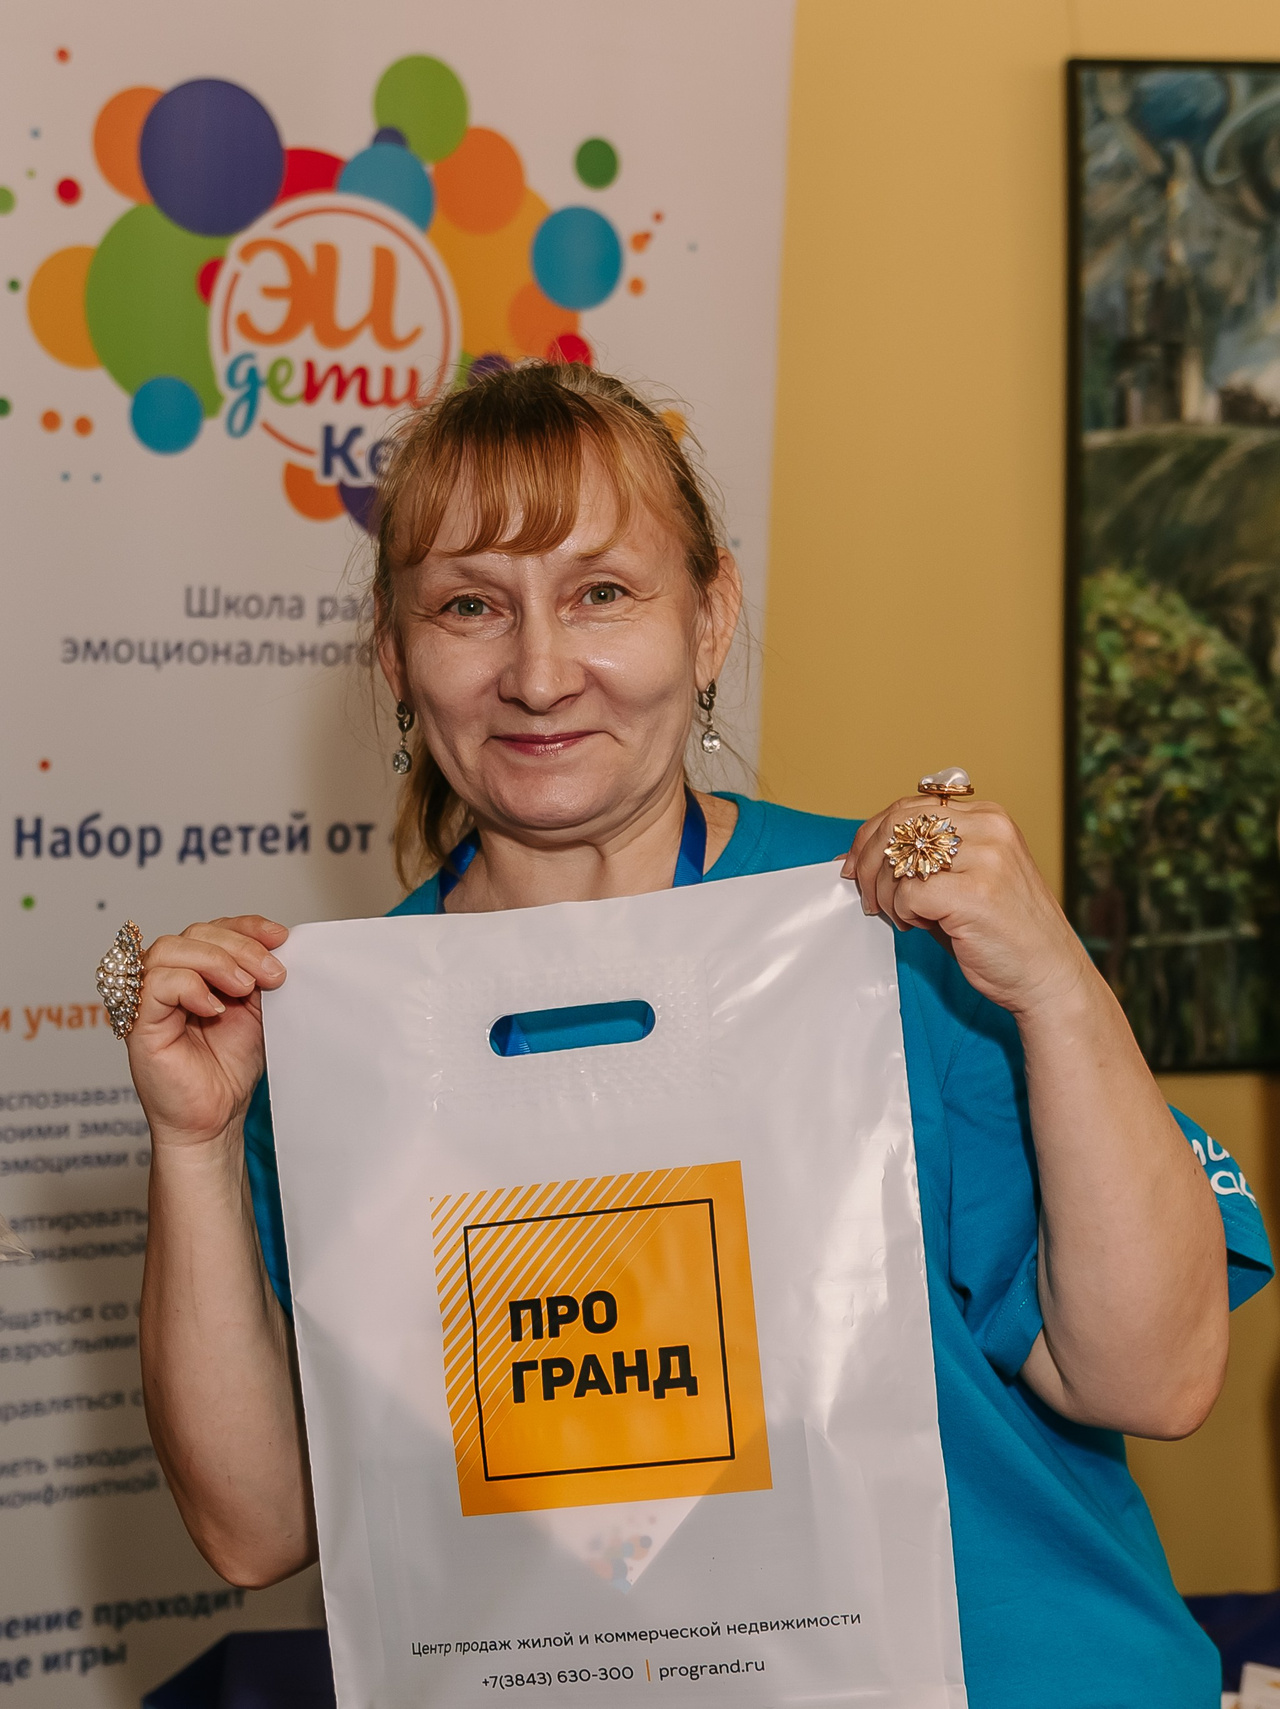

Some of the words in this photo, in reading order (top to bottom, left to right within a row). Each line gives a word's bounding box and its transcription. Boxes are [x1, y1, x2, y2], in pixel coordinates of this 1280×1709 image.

[226, 352, 426, 439] дети
[184, 585, 305, 621] Школа
[14, 811, 162, 869] Набор
[178, 811, 311, 864] детей
[327, 822, 376, 854] от
[0, 1152, 129, 1177] эмоциями
[509, 1290, 618, 1343] ПРО
[511, 1345, 699, 1404] ГРАНД
[91, 1588, 245, 1632] проходит
[411, 1641, 452, 1658] Центр
[455, 1638, 512, 1656] продаж
[517, 1632, 574, 1650] жилой
[578, 1633, 589, 1646] и
[594, 1621, 721, 1644] коммерческой
[726, 1612, 862, 1635] недвижимости
[41, 1642, 128, 1676] игры
[482, 1671, 553, 1690] +7(3843)
[557, 1665, 634, 1684] 630-300
[658, 1658, 766, 1681] progrand.ru
